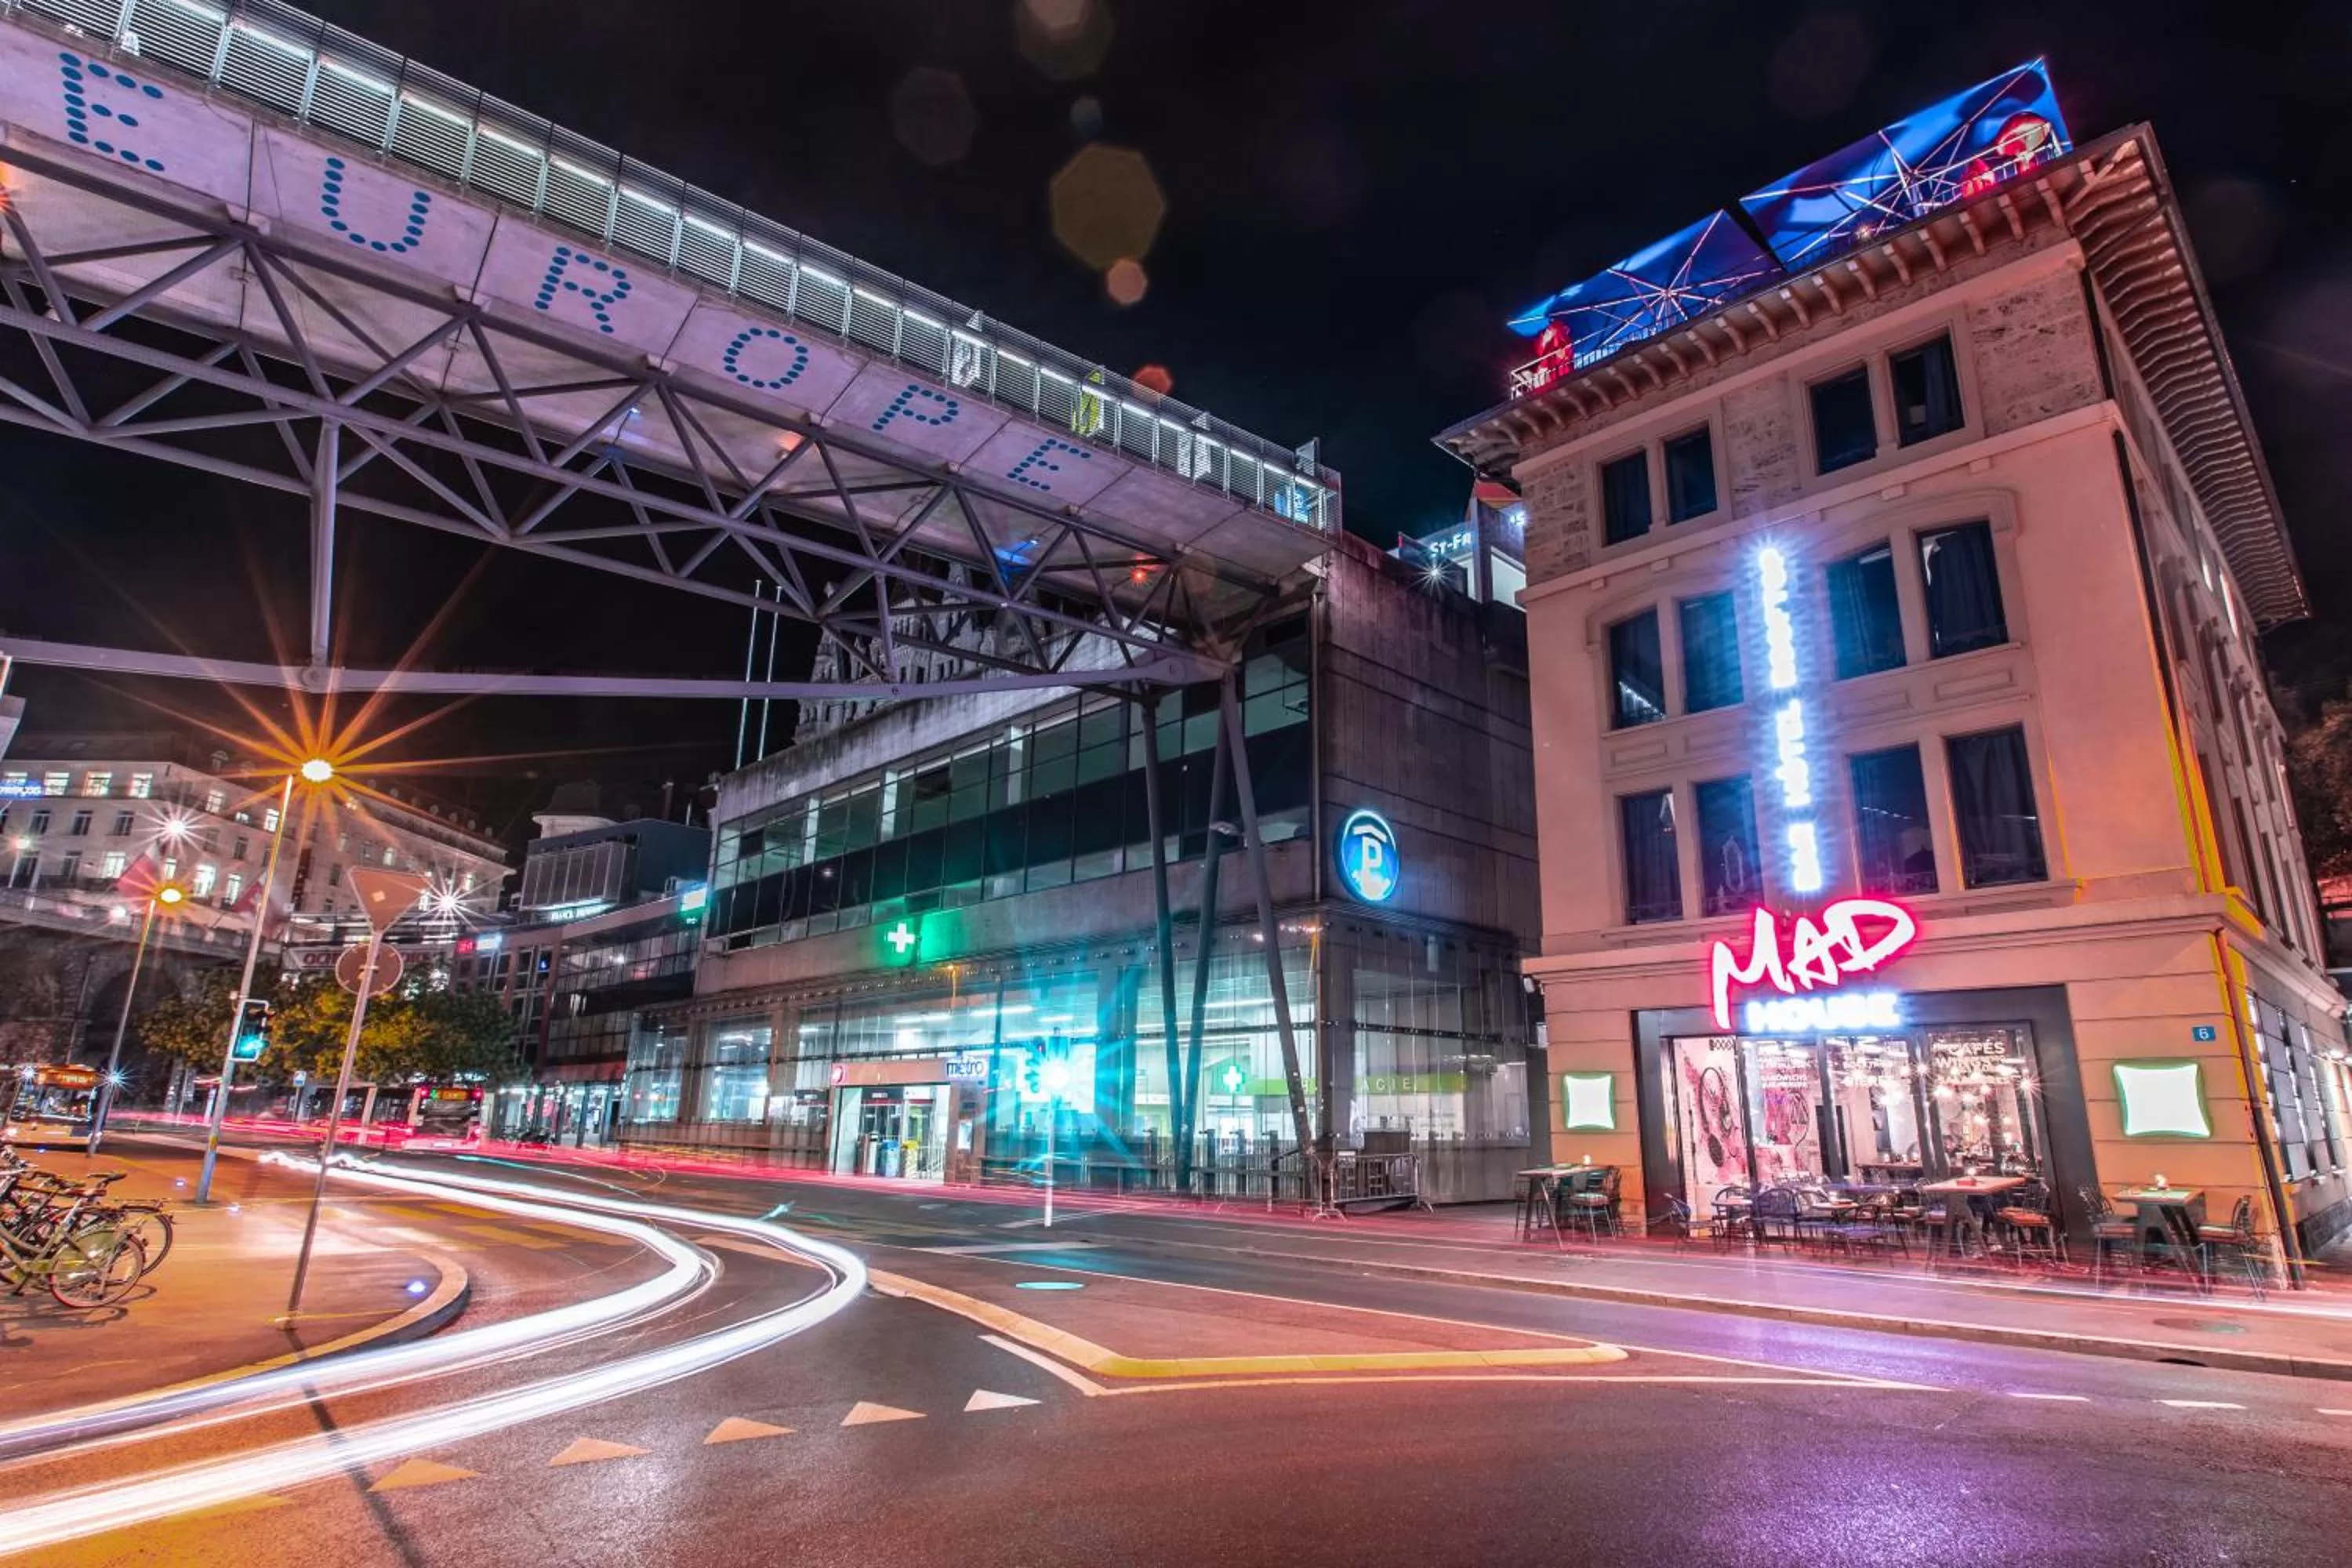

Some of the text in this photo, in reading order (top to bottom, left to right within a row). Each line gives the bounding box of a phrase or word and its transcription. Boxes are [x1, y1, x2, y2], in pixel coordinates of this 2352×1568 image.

[59, 52, 1091, 492] EUROPE
[1711, 899, 1917, 1029] MAD
[1748, 993, 1900, 1031] HOUSE
